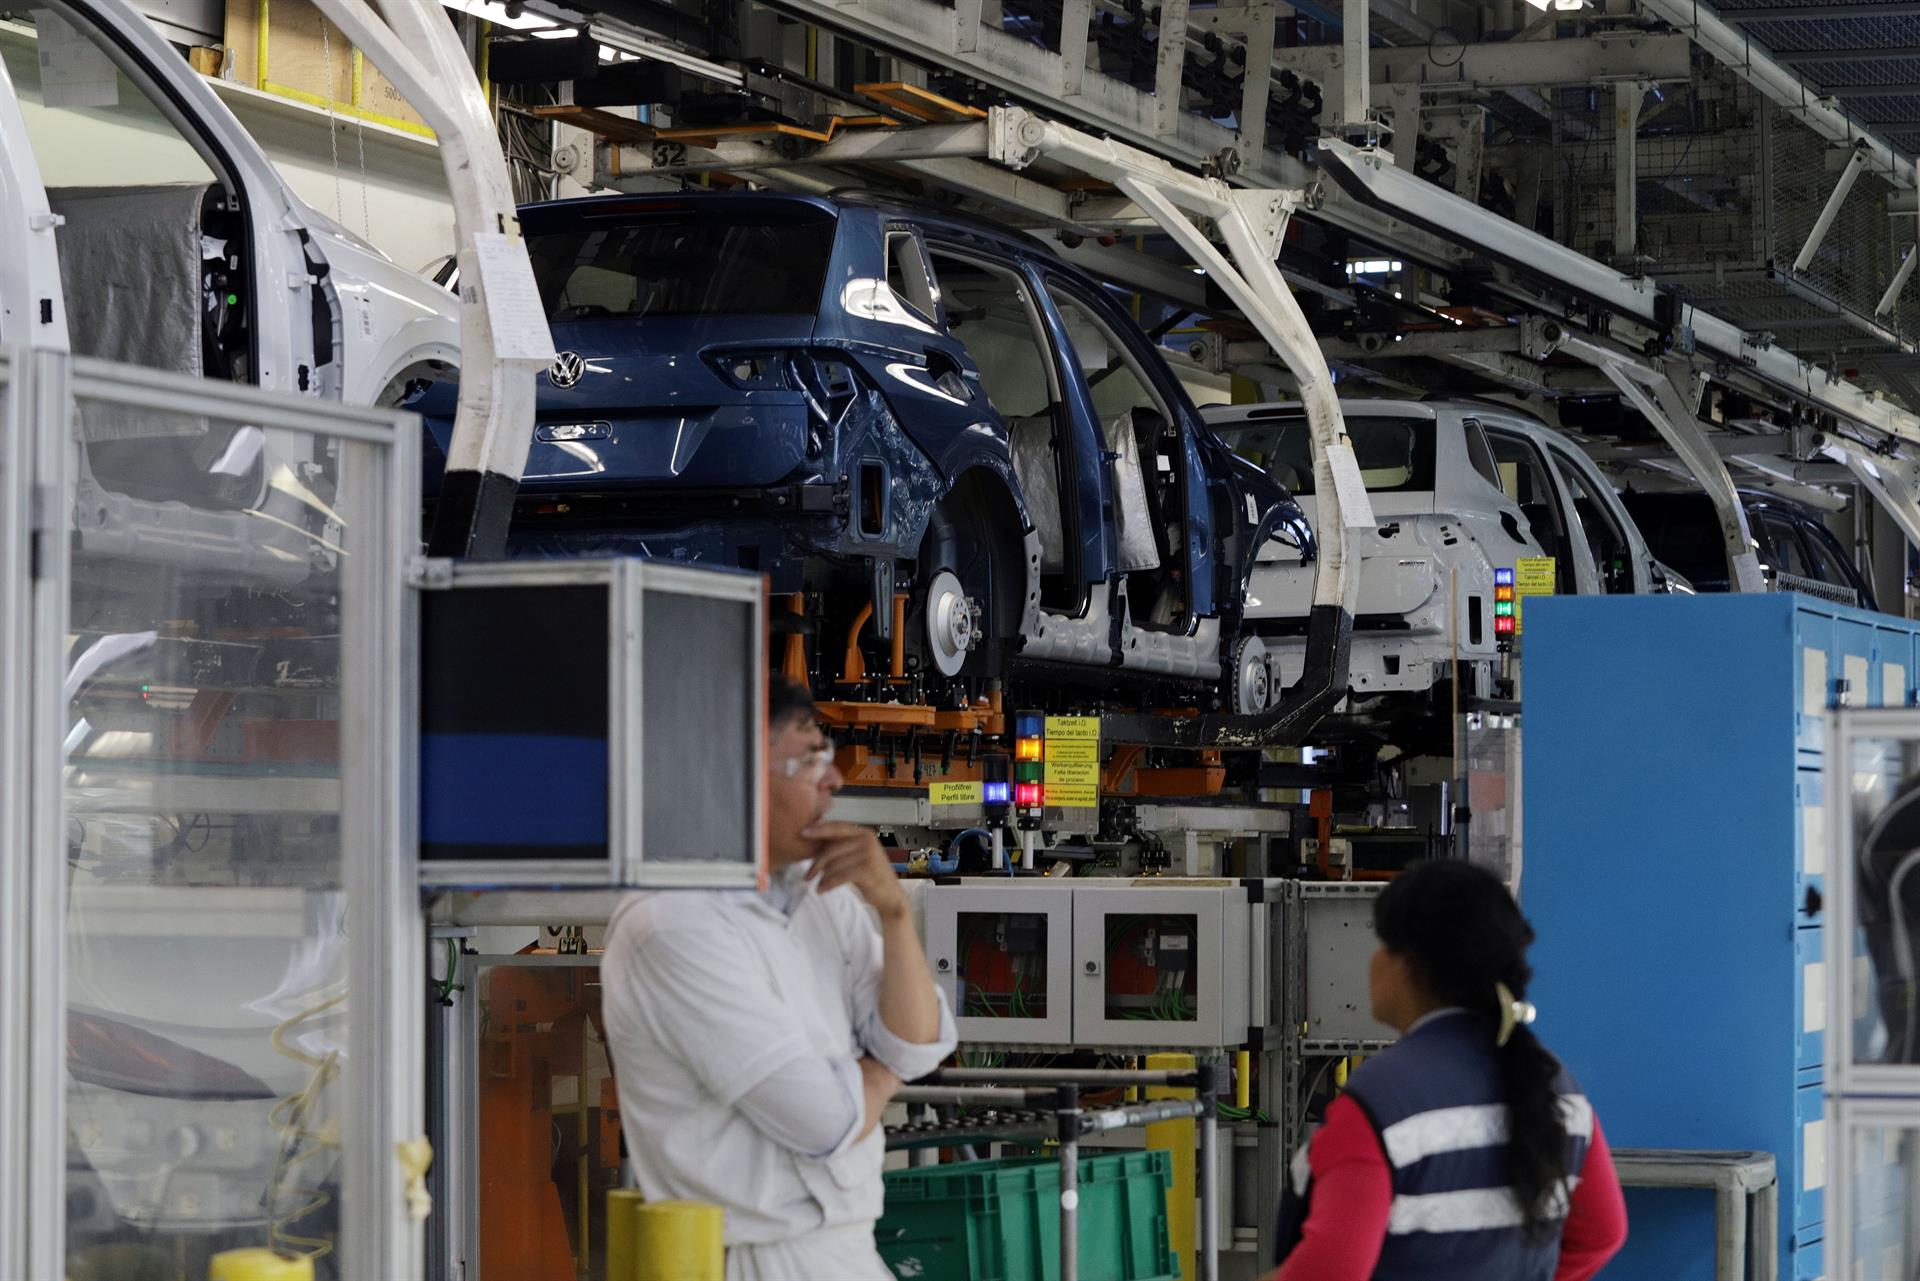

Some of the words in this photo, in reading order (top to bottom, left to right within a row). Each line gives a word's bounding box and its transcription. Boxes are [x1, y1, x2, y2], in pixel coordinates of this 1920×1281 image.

[653, 142, 687, 167] 32
[943, 783, 972, 791] Profilfrei
[941, 793, 959, 801] Perfil
[959, 793, 975, 801] libre
